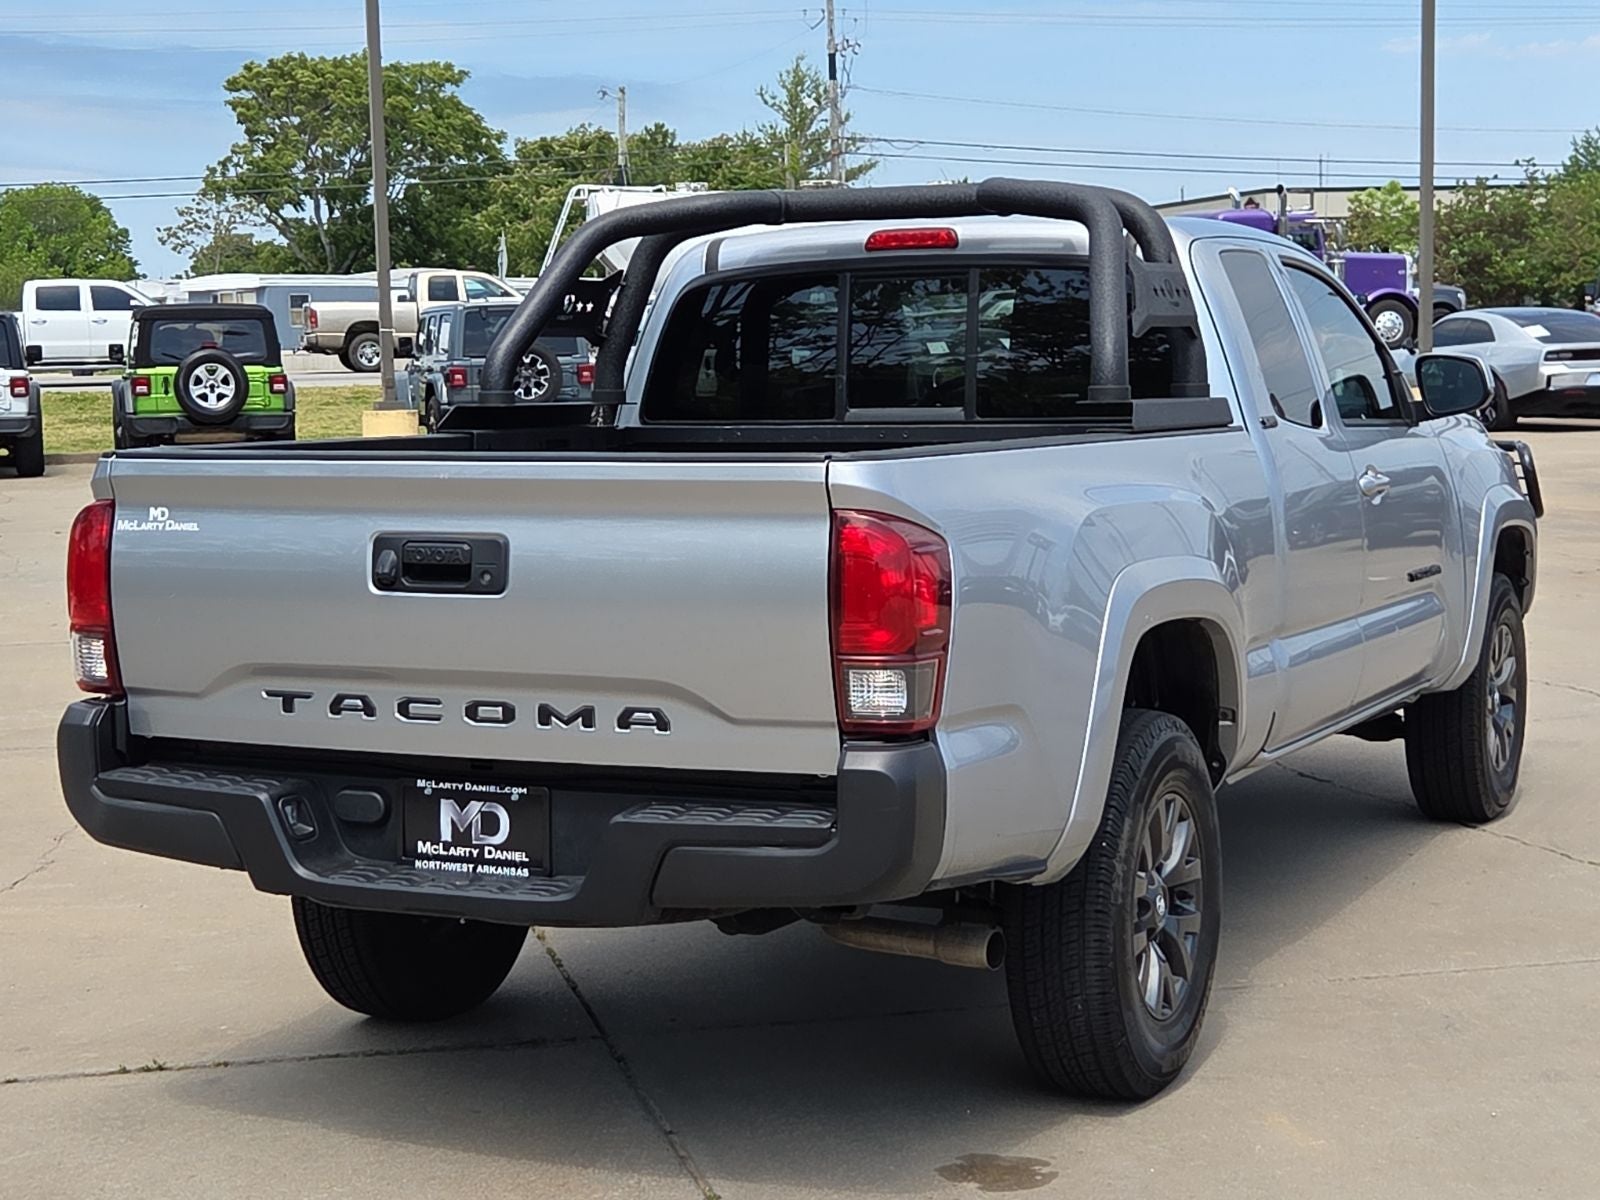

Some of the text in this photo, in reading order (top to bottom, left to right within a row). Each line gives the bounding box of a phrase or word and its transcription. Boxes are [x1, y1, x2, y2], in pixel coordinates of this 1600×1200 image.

[149, 507, 169, 521] MD
[405, 547, 466, 564] TOYOTA
[261, 689, 671, 735] TACOMA
[440, 798, 510, 845] MD
[414, 859, 530, 878] NORTHWEST ARKANSAS
